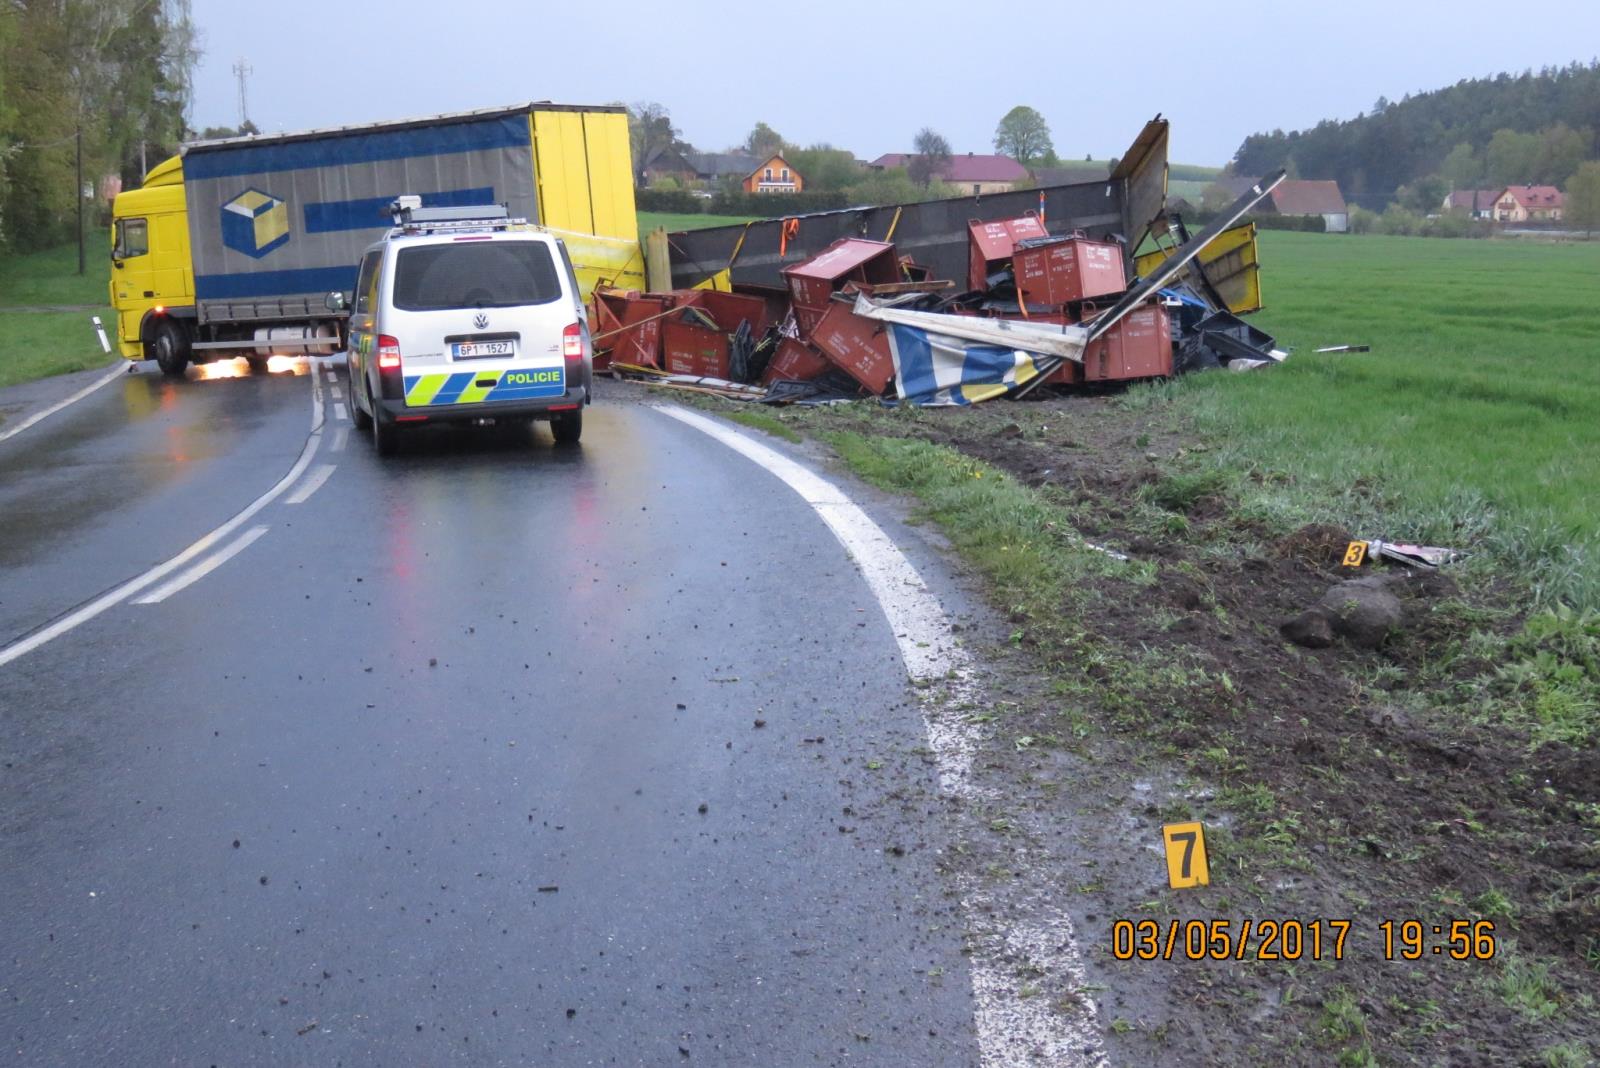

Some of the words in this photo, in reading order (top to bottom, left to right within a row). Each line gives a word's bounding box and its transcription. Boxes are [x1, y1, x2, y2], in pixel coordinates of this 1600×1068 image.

[460, 344, 478, 356] 6P1
[486, 343, 508, 354] 1527
[507, 371, 560, 384] POLICIE
[1347, 545, 1362, 563] 3
[1170, 831, 1197, 879] 7
